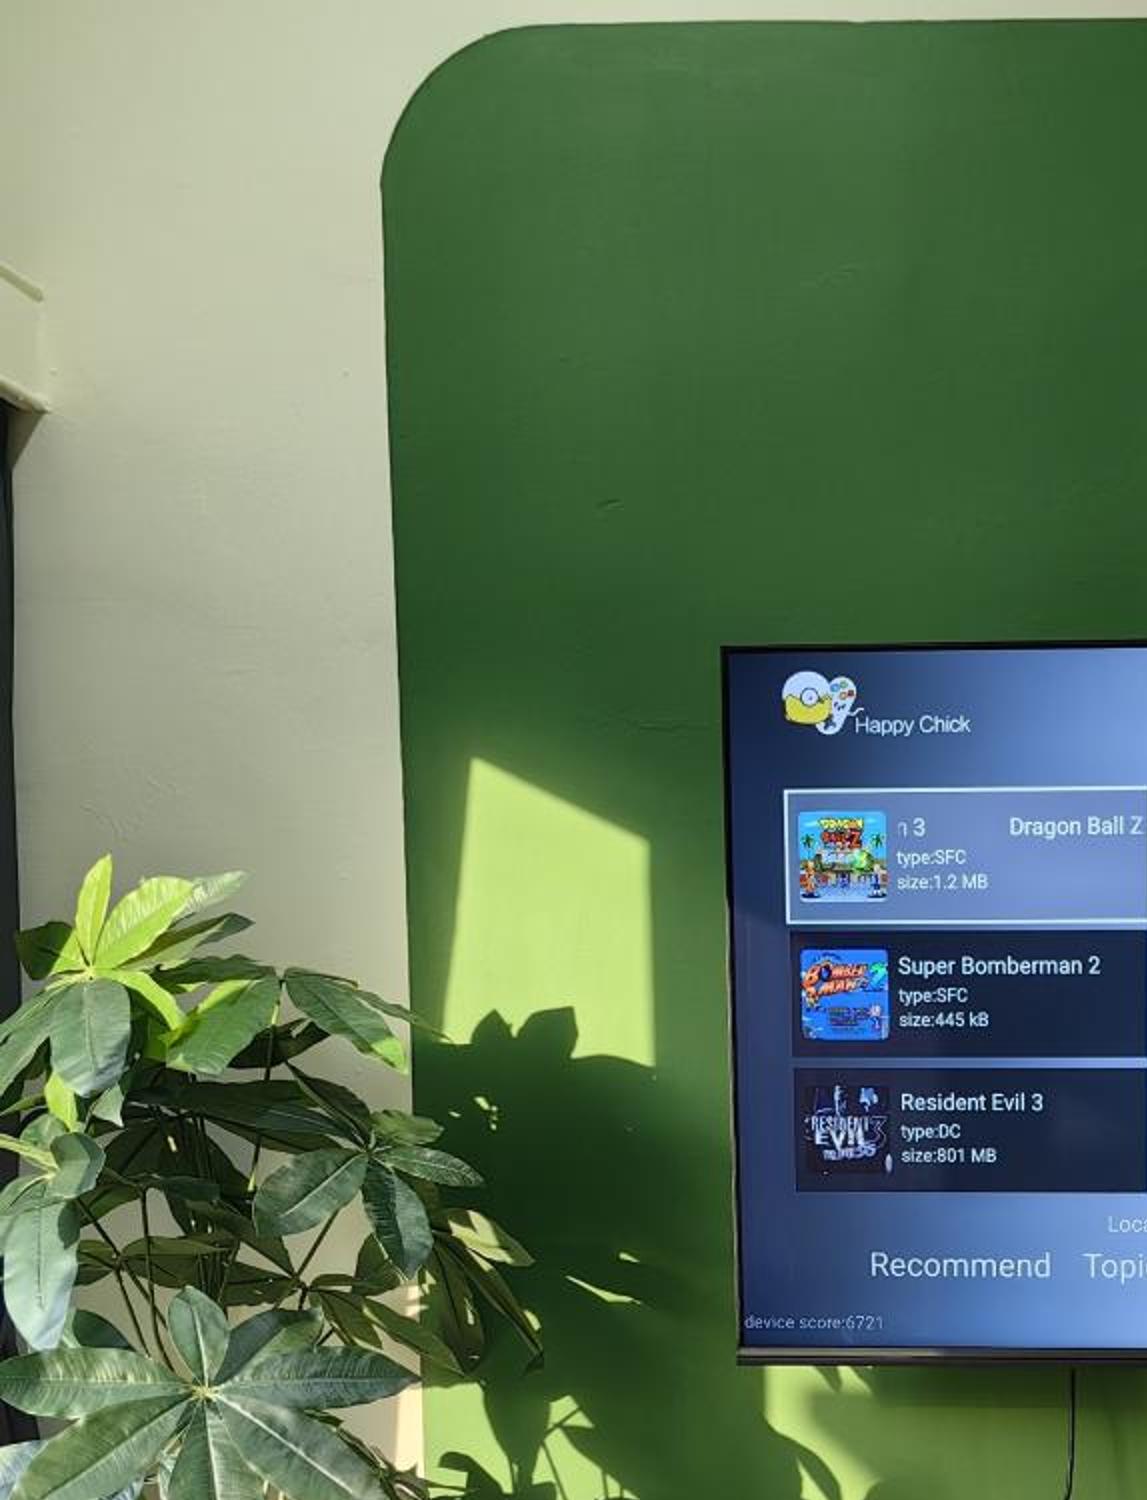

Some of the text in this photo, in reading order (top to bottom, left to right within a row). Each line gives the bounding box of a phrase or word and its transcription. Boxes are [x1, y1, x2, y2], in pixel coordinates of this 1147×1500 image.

[855, 714, 971, 736] Happy Chick
[912, 817, 926, 836] 3
[1009, 817, 1081, 840] Dragon
[1087, 816, 1124, 835] Ball
[1130, 816, 1145, 835] Z
[896, 849, 967, 869] type:SFC
[897, 873, 989, 890] size:1.2 MB
[898, 956, 1101, 979] Super Bomberman 2
[899, 986, 969, 1007] type:SFC
[900, 1010, 990, 1029] size:445 kB
[900, 1092, 1044, 1112] Resident Evil 3
[901, 1122, 961, 1142] type:DC
[902, 1147, 997, 1165] size:801 MB
[870, 1252, 1051, 1279] Recommend
[745, 1314, 884, 1331] device score:6721
